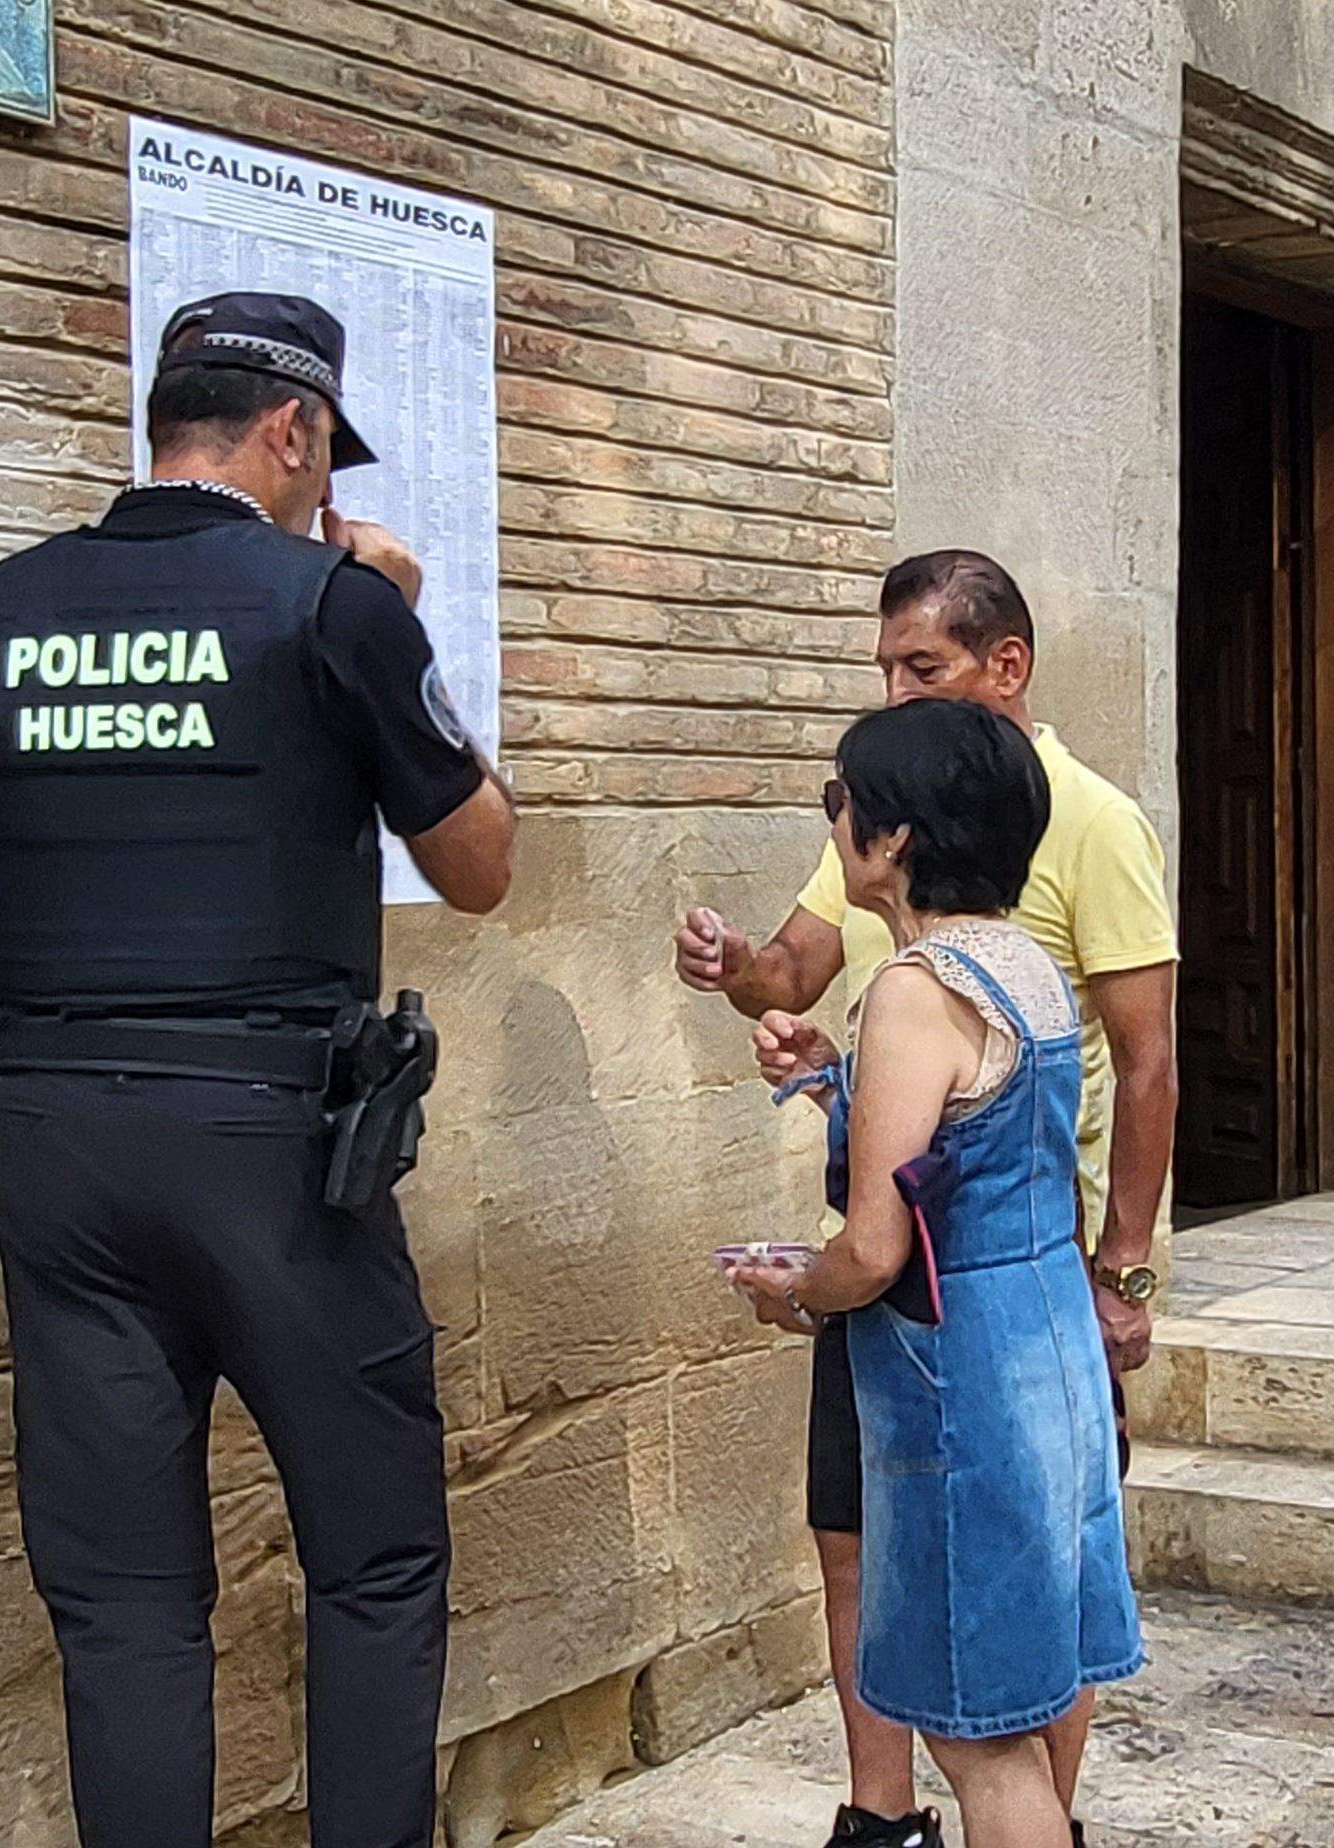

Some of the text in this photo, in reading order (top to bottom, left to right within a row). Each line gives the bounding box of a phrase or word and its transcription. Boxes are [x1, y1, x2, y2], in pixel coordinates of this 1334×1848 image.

[137, 164, 188, 192] BANDO
[138, 136, 306, 198] ALCALDÍA
[318, 181, 359, 211] DE
[369, 193, 487, 243] HUESCA
[6, 629, 230, 689] POLICIA
[19, 702, 216, 751] HUESCA
